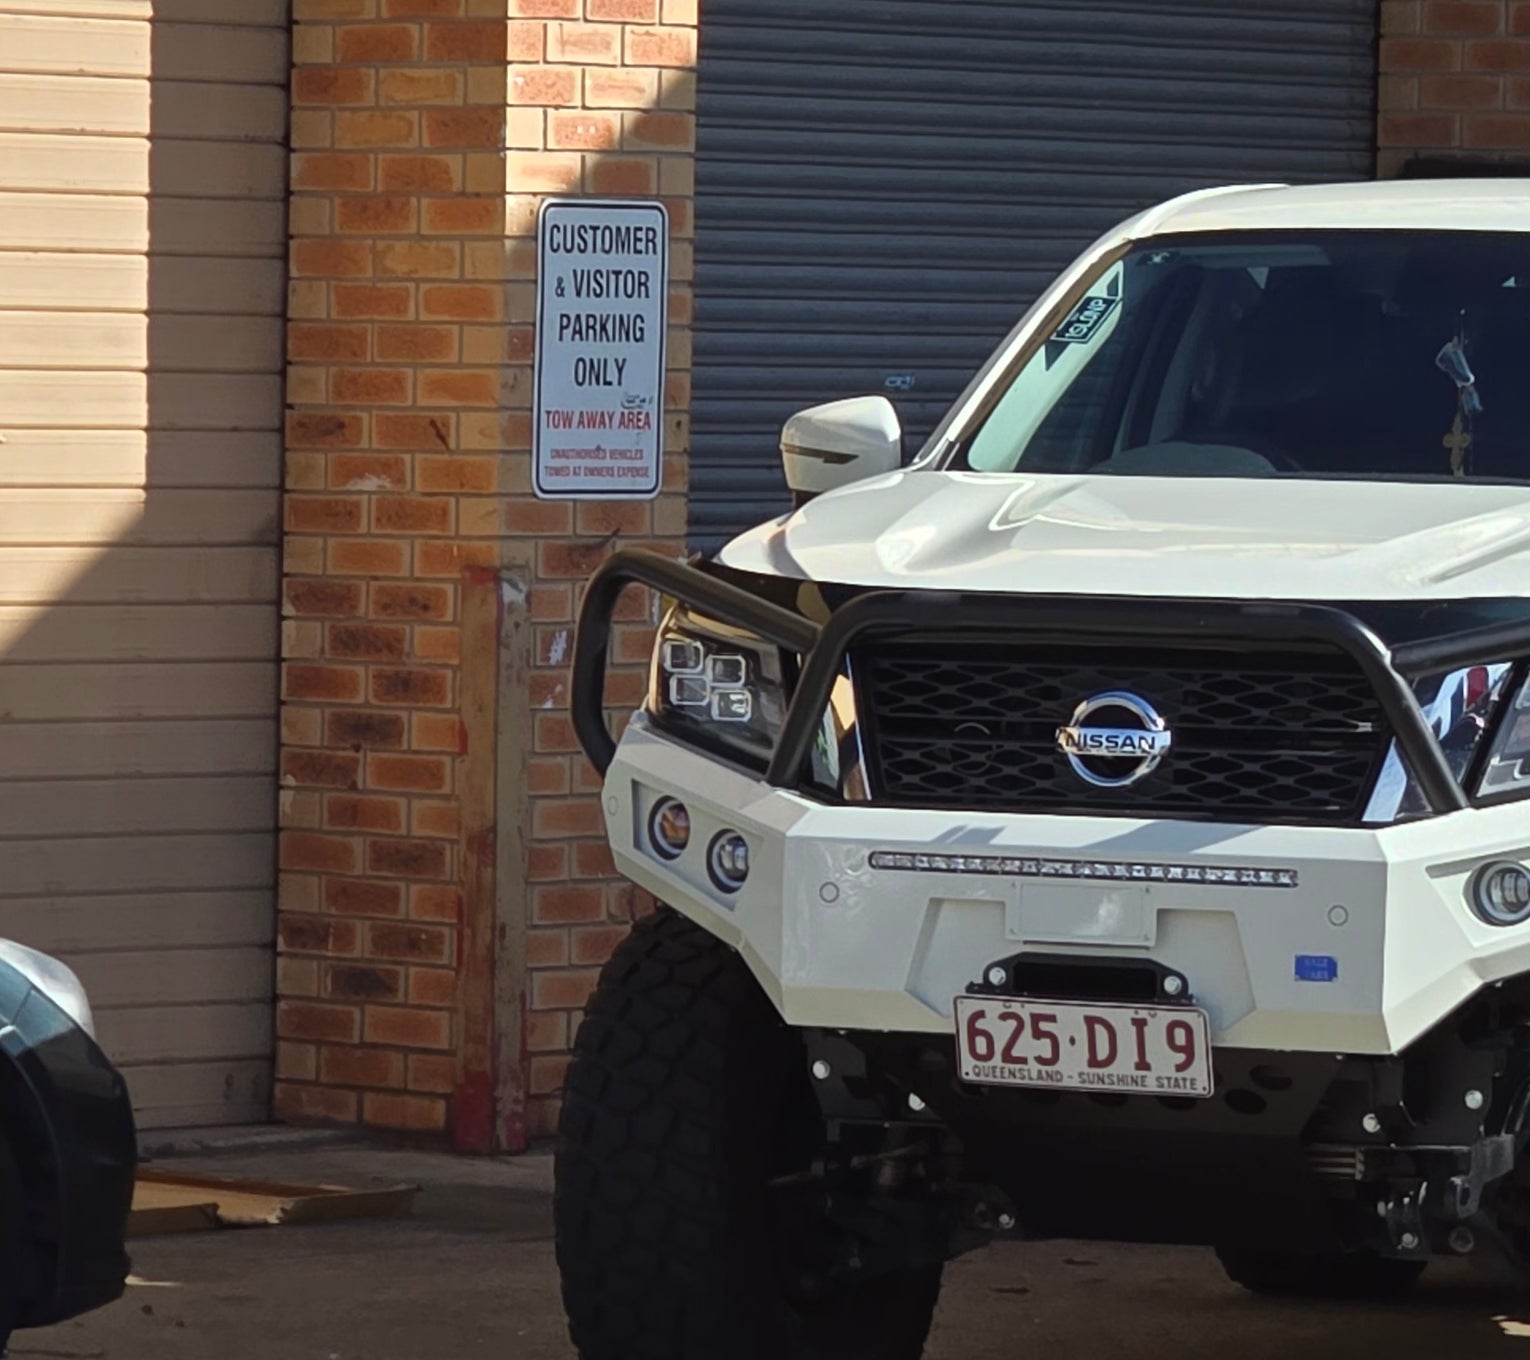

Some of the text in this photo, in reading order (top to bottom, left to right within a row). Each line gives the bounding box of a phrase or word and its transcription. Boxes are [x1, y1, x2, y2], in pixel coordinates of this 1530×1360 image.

[550, 224, 657, 256] CUSTOMER
[555, 268, 650, 299] & VISITOR
[558, 313, 645, 343] PARKING
[574, 357, 627, 387] ONLY
[545, 410, 651, 430] TOW AWAY AREA
[1064, 730, 1155, 751] NISSAN
[973, 1066, 1064, 1083] QUEENSLAND
[1078, 1071, 1148, 1088] SUNSHINE
[1155, 1076, 1197, 1091] STATE
